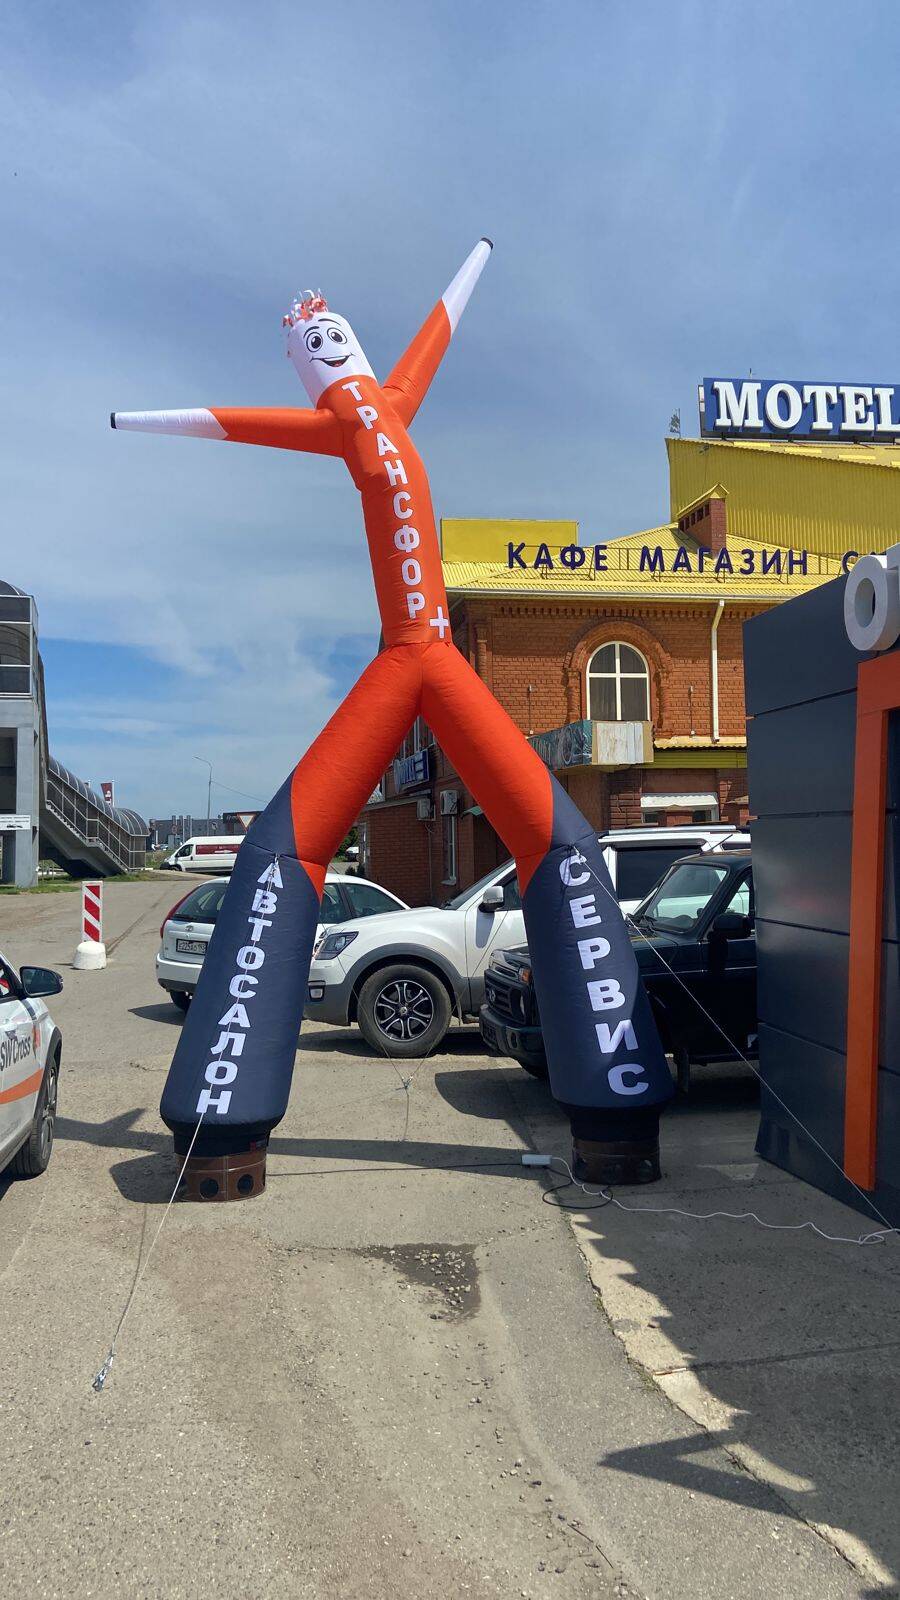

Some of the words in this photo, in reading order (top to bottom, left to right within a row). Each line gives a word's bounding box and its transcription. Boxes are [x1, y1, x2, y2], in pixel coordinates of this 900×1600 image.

[713, 381, 900, 431] MOTEL
[507, 542, 608, 570] КАФЕ
[639, 546, 808, 576] МАГАЗИН
[195, 862, 284, 1114] АВТОСАЛОН
[558, 854, 649, 1096] СЕРВИС
